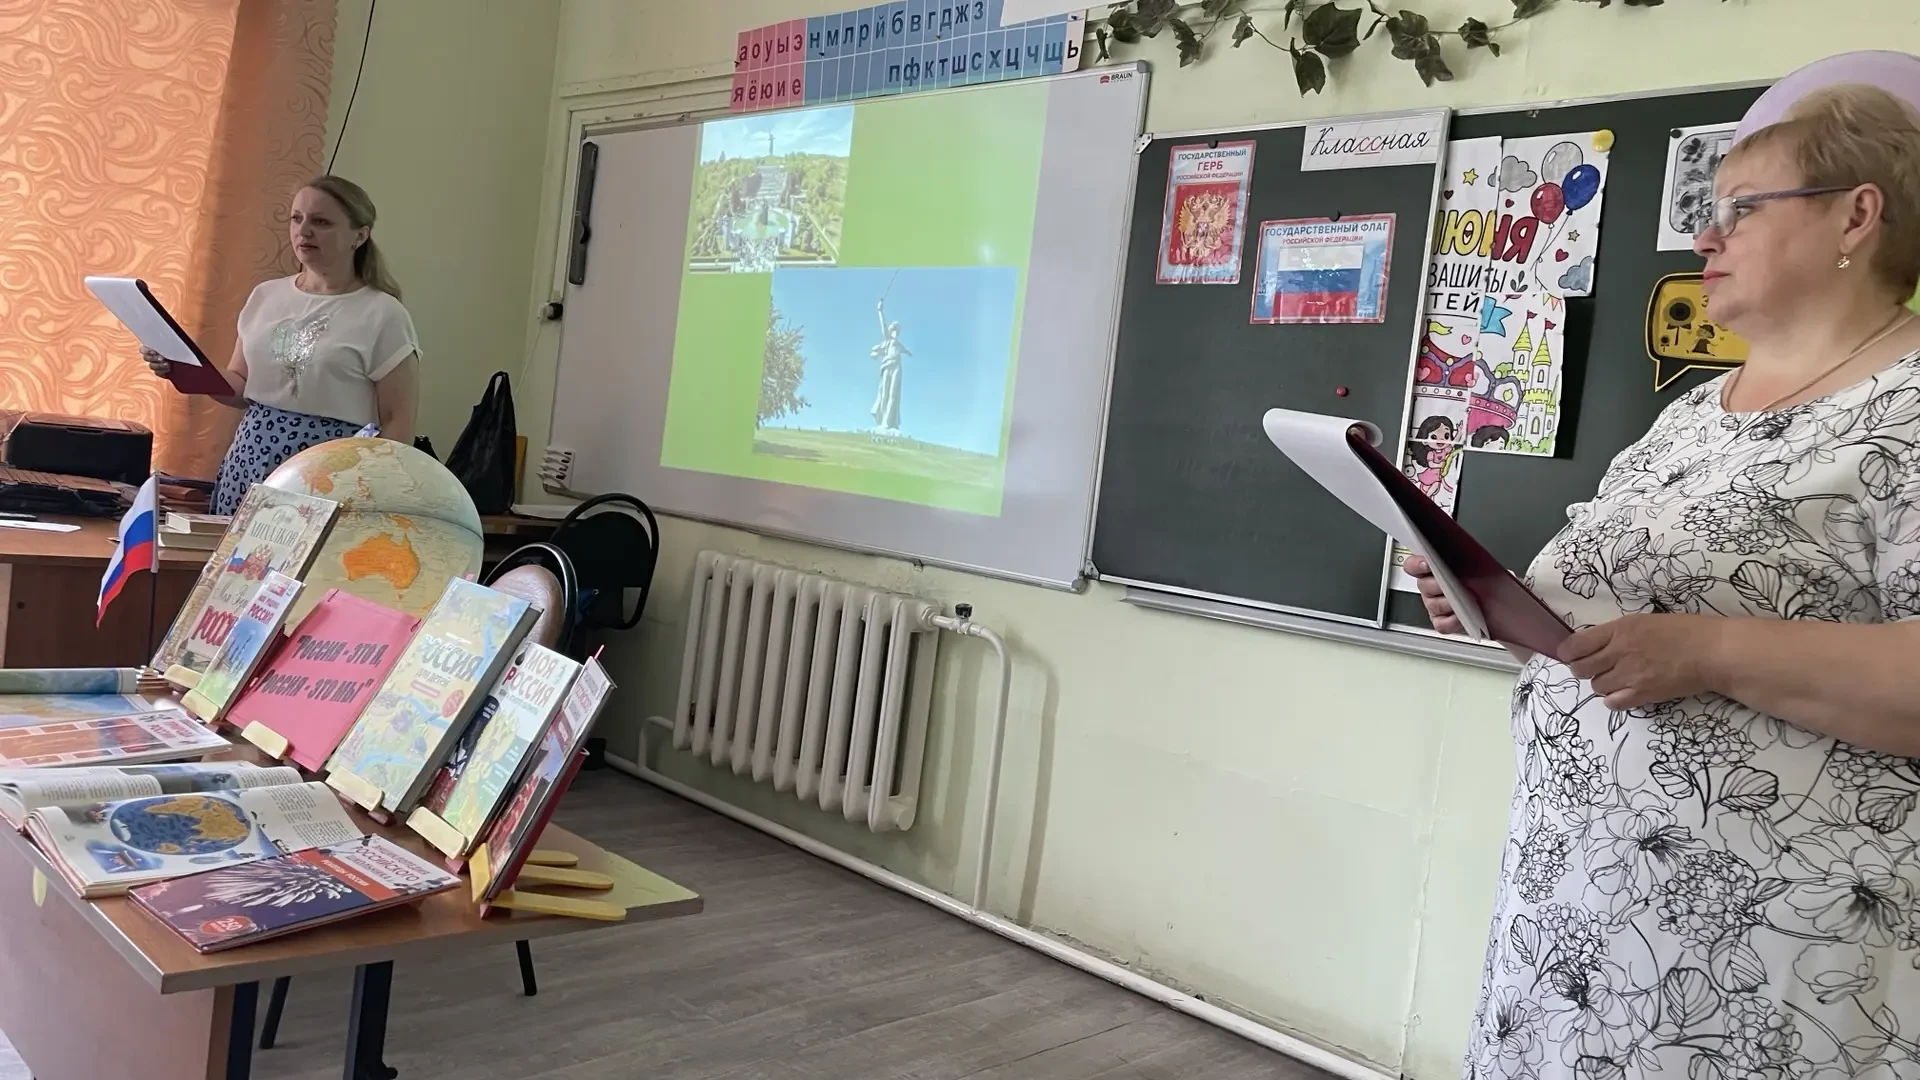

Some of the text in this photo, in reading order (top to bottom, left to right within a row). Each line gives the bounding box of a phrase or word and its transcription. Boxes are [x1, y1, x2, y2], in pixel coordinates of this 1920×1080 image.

[1110, 72, 1133, 81] BRAUN
[1310, 126, 1430, 155] Классная
[1178, 149, 1247, 161] ГОСУДАРСТВЕННЫЙ
[1197, 161, 1224, 172] ГЕРБ
[1176, 171, 1244, 181] РОССИЙСКОЙ ФЕДЕРАЦИИ
[1265, 222, 1389, 237] ГОСУДАРСТВЕННЫЙ ФЛАГ
[1282, 235, 1364, 245] РОССИЙСКОЙ ФЕДЕРАЦИИ
[524, 650, 556, 680] МОЯ
[502, 665, 555, 708] РОССИЯ
